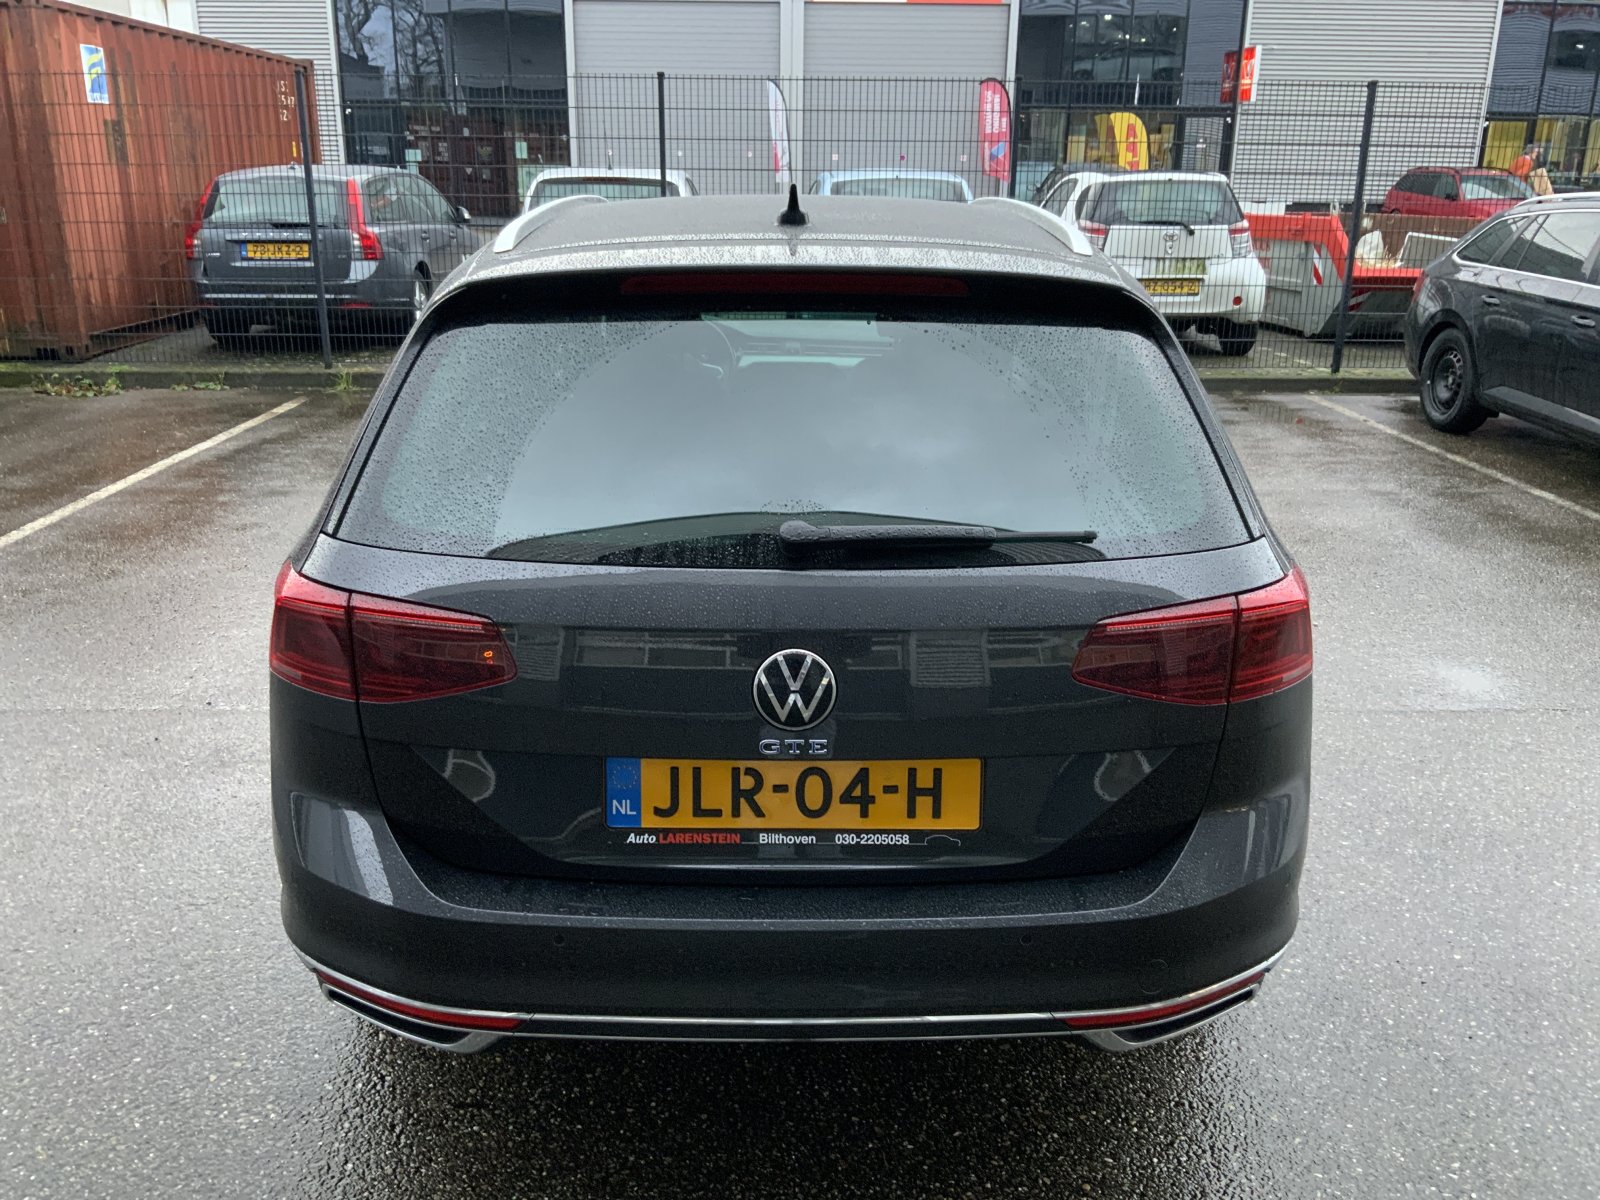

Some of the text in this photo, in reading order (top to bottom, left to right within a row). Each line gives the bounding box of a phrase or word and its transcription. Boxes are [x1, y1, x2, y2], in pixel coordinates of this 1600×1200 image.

[759, 739, 828, 755] GTE
[653, 766, 943, 819] JLR-04-H
[612, 799, 637, 815] NL
[626, 833, 910, 845] Auto LARENSTEIN Bilthoven 030-2205058
